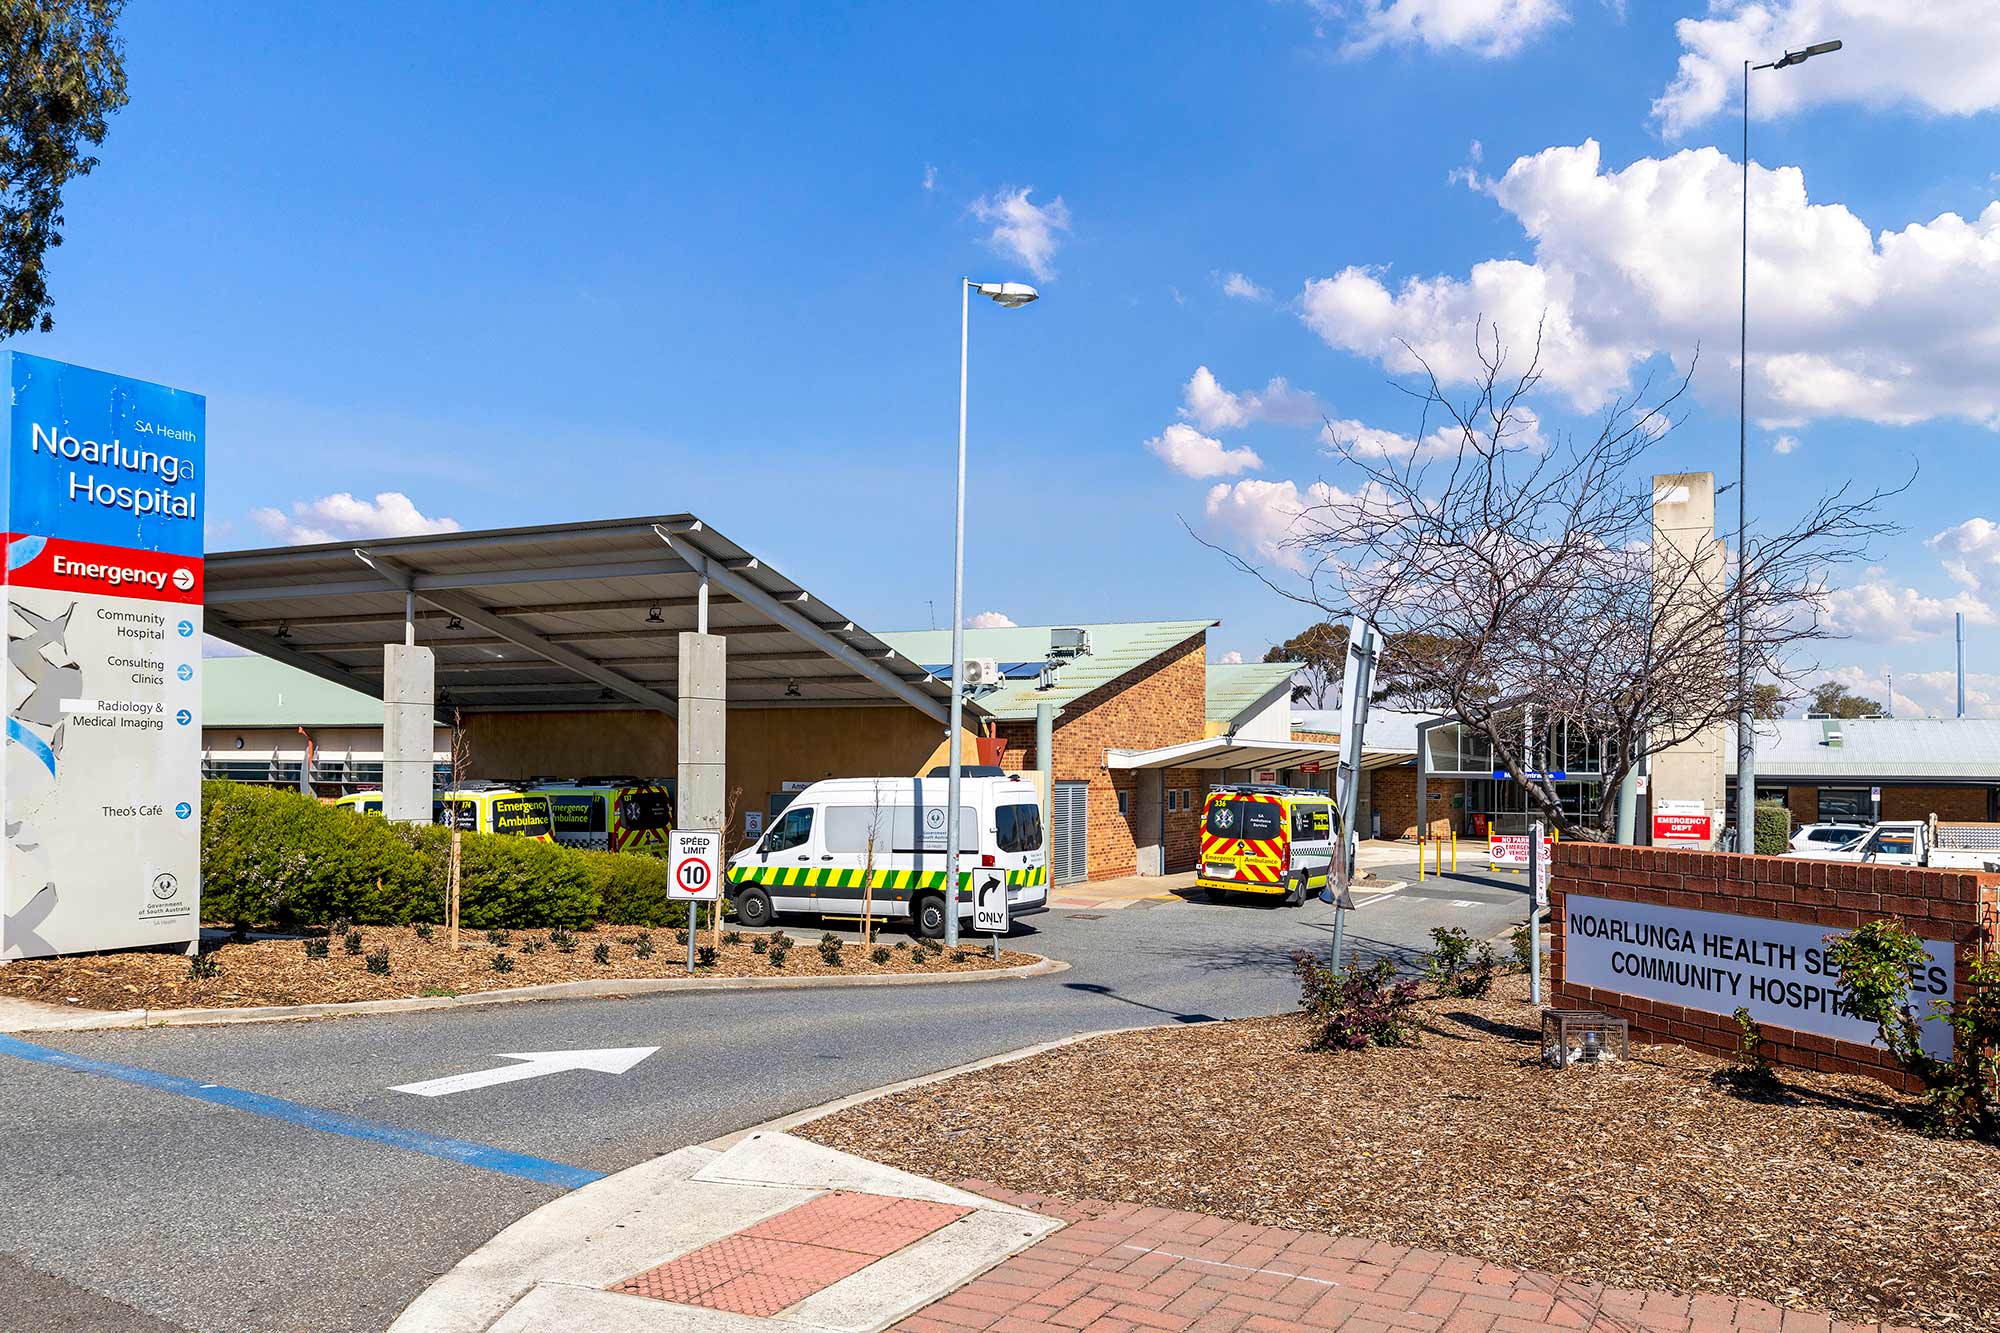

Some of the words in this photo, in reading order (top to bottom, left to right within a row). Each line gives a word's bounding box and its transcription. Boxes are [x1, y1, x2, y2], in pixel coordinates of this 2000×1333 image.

[135, 420, 153, 433] SA
[157, 424, 196, 443] Health
[32, 422, 195, 482] Noarlunga
[69, 471, 196, 518] Hospital
[53, 555, 168, 589] Emergency
[96, 608, 165, 627] Community
[117, 626, 165, 640] Hospital
[107, 656, 164, 672] Consulting
[131, 673, 164, 685] Clinics
[98, 700, 153, 714] Radiology
[155, 702, 164, 713] &
[73, 715, 116, 727] Medical
[120, 717, 164, 730] Imaging
[102, 805, 137, 817] Theo's
[139, 804, 163, 816] Café
[496, 800, 547, 814] Emergency
[551, 803, 589, 814] mergency
[497, 815, 549, 828] Ambulance
[552, 813, 589, 823] mbulance
[1657, 817, 1707, 825] EMERGENCY
[680, 836, 710, 846] SPEED
[1502, 836, 1512, 844] NO
[1512, 836, 1530, 844] PARK
[683, 866, 705, 884] 10
[978, 911, 1004, 924] ONLY
[1570, 913, 1696, 954] NOARLUNGA
[1703, 932, 1796, 971] HEALTH
[1804, 948, 1948, 996] SEES
[1611, 951, 1742, 996] COMMUNITY
